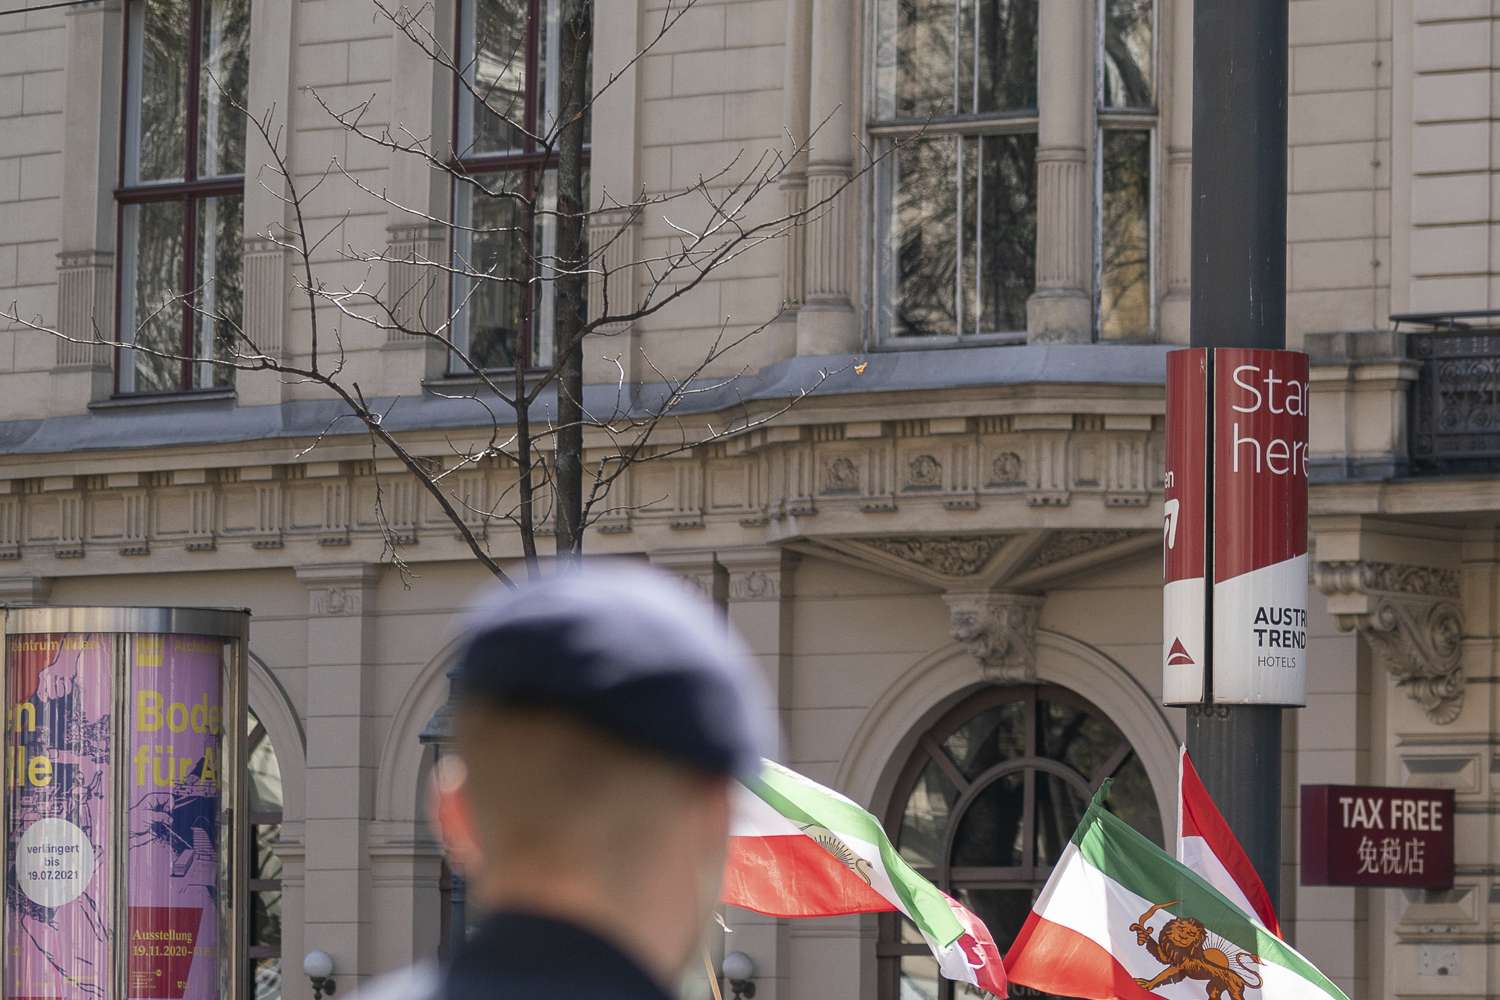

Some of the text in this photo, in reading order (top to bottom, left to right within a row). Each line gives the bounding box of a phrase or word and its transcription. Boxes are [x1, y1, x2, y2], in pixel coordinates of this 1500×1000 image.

[1253, 629, 1307, 649] TREND
[1257, 656, 1296, 668] HOTELS
[134, 743, 193, 787] für
[1339, 797, 1443, 831] TAX FREE
[44, 858, 60, 868] bis
[133, 929, 193, 944] Ausstellung
